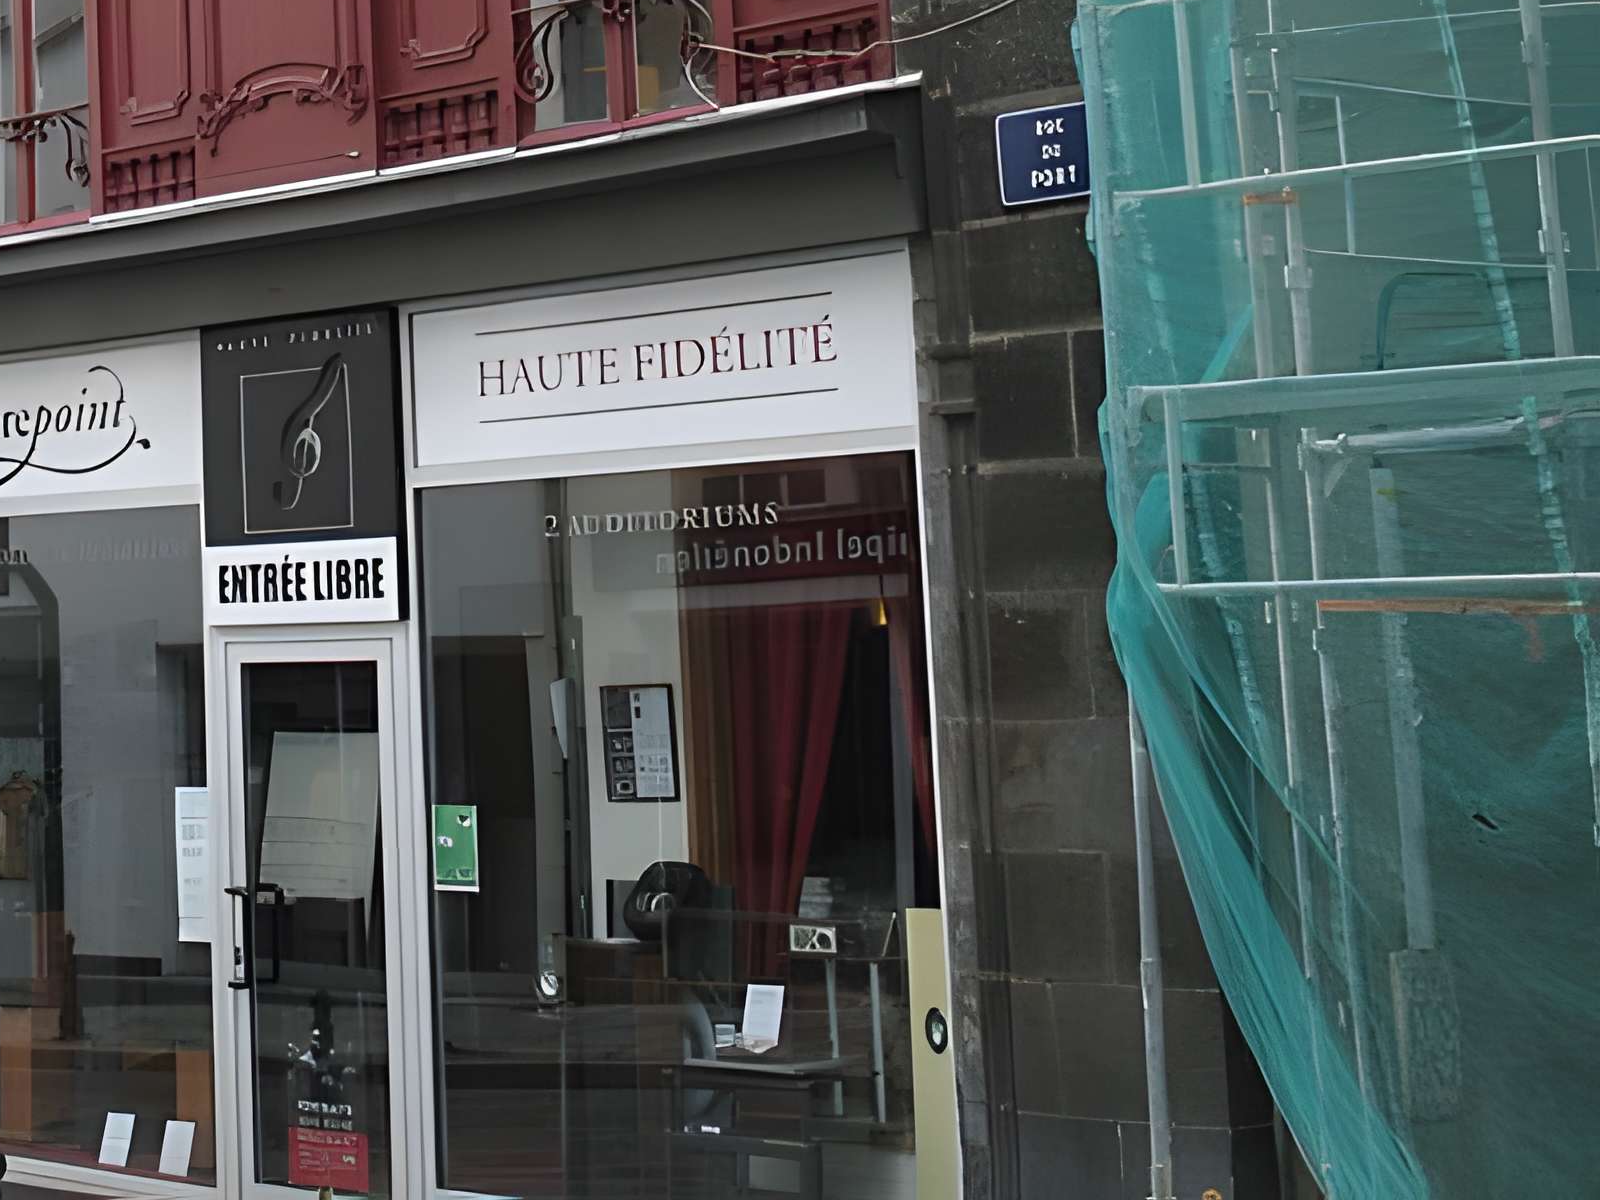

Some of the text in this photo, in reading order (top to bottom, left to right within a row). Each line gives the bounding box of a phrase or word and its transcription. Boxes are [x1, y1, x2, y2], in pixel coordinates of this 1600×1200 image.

[478, 313, 838, 398] HAUTE FIDÉLITÉ
[567, 501, 779, 537] AUDITORIUMS
[218, 553, 385, 605] ENTRÉE LIBRE
